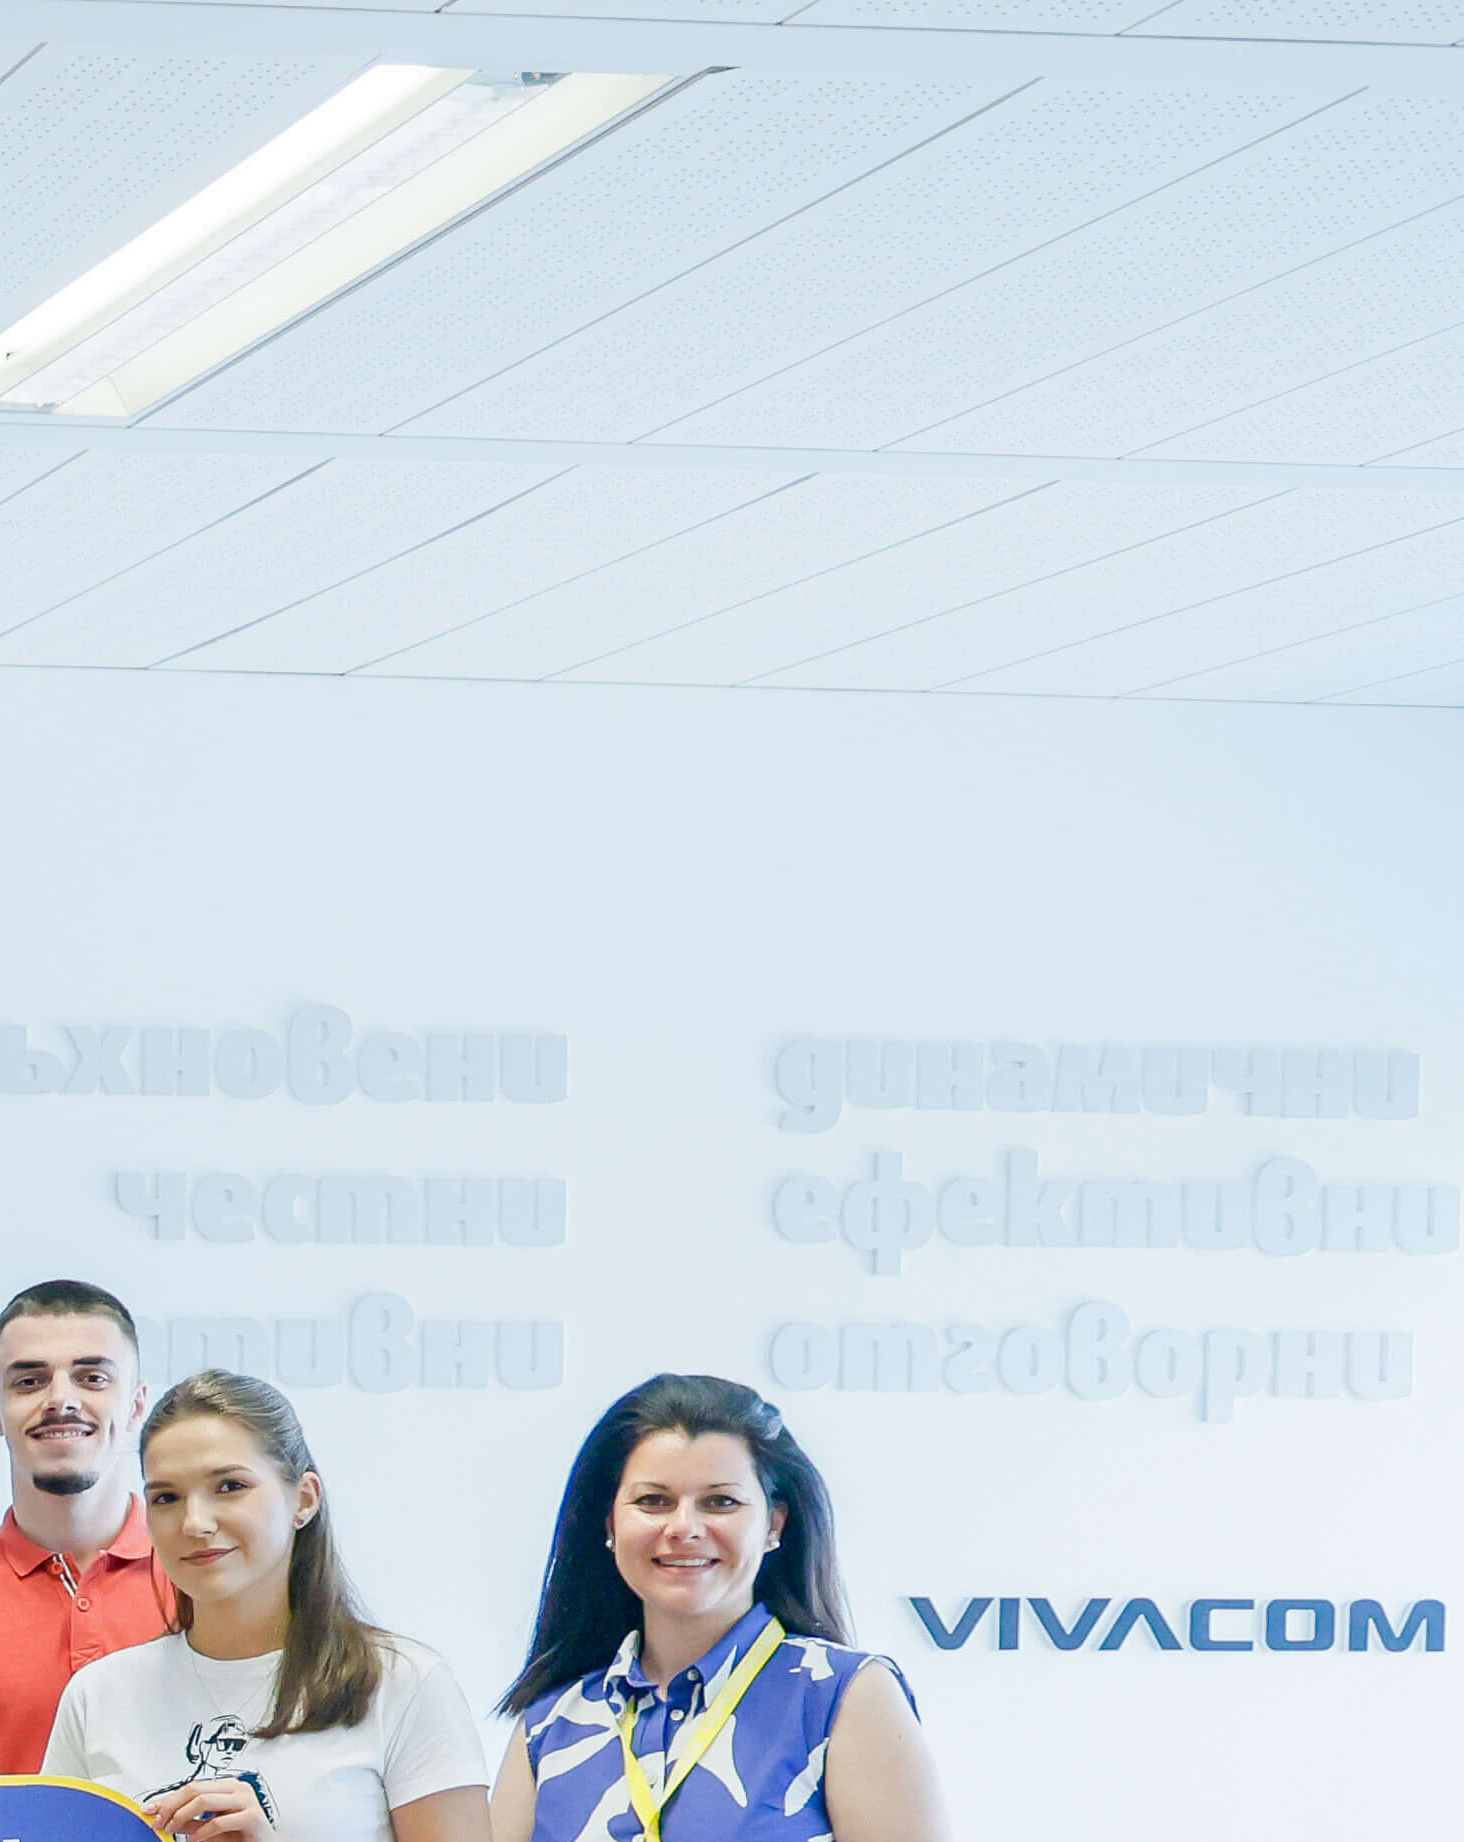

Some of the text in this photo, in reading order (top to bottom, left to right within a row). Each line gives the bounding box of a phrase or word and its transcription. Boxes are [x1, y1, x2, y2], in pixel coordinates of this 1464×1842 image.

[775, 1036, 1420, 1133] динамични
[114, 1170, 568, 1247] честни
[771, 1147, 1461, 1276] ефективни
[768, 1300, 1414, 1423] отговорни
[909, 1597, 1446, 1652] VIVACOM
